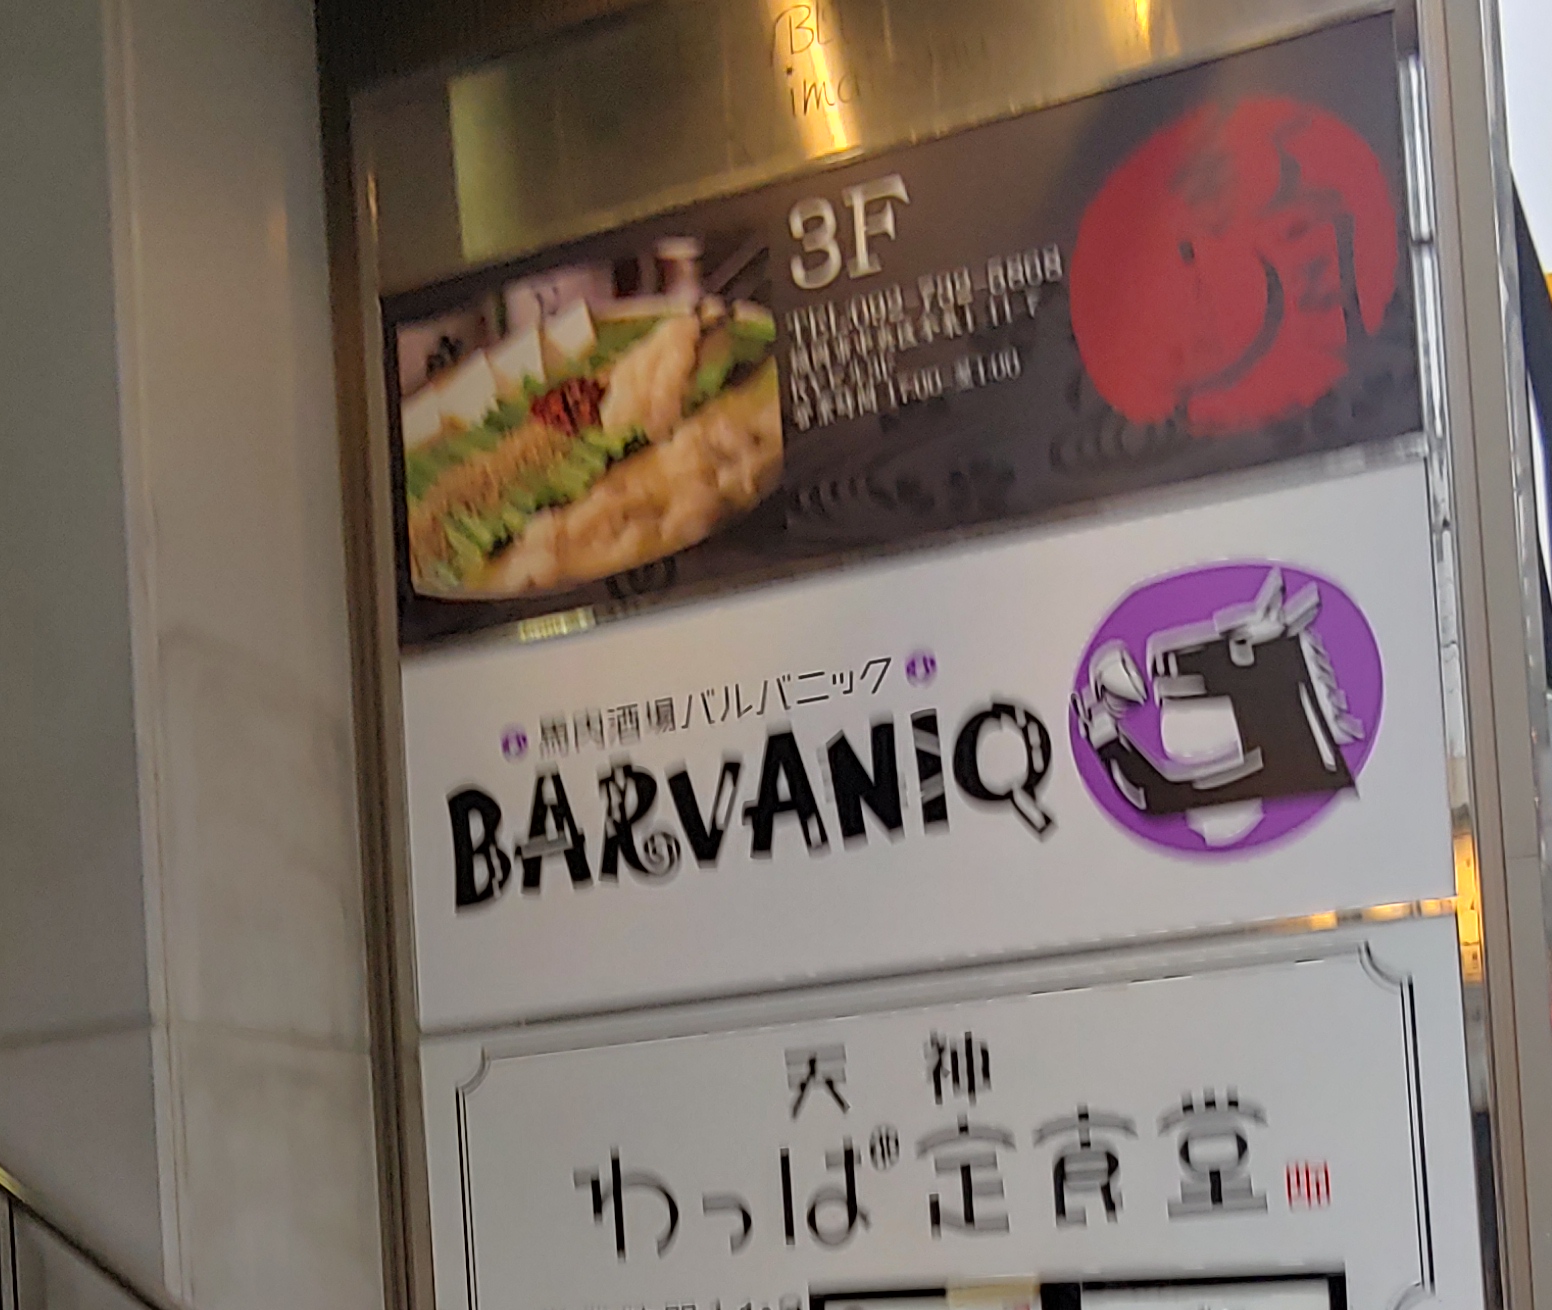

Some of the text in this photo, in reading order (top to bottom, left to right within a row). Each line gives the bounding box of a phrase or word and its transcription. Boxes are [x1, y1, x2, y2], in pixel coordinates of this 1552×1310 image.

[789, 174, 910, 290] 3F
[573, 1085, 1269, 1263] わっぱ定食堂
